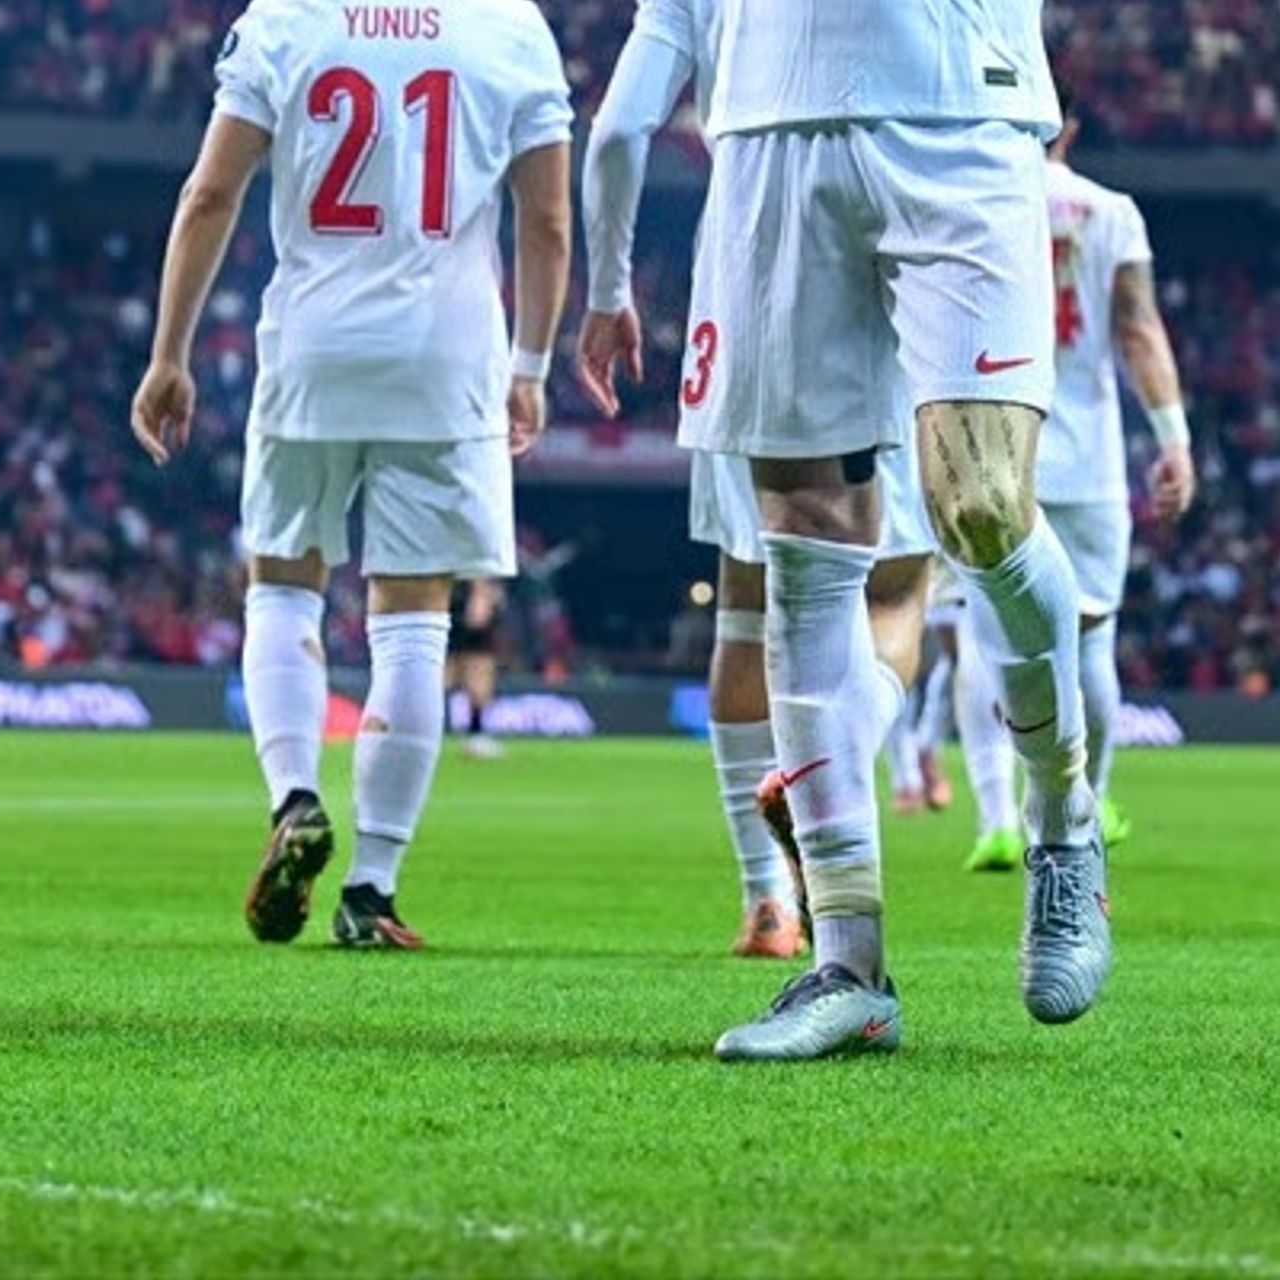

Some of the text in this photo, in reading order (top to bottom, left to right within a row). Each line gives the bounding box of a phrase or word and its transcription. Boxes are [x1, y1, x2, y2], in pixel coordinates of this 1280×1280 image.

[343, 6, 440, 40] YUNUS
[306, 66, 458, 239] 21
[683, 318, 720, 409] 3
